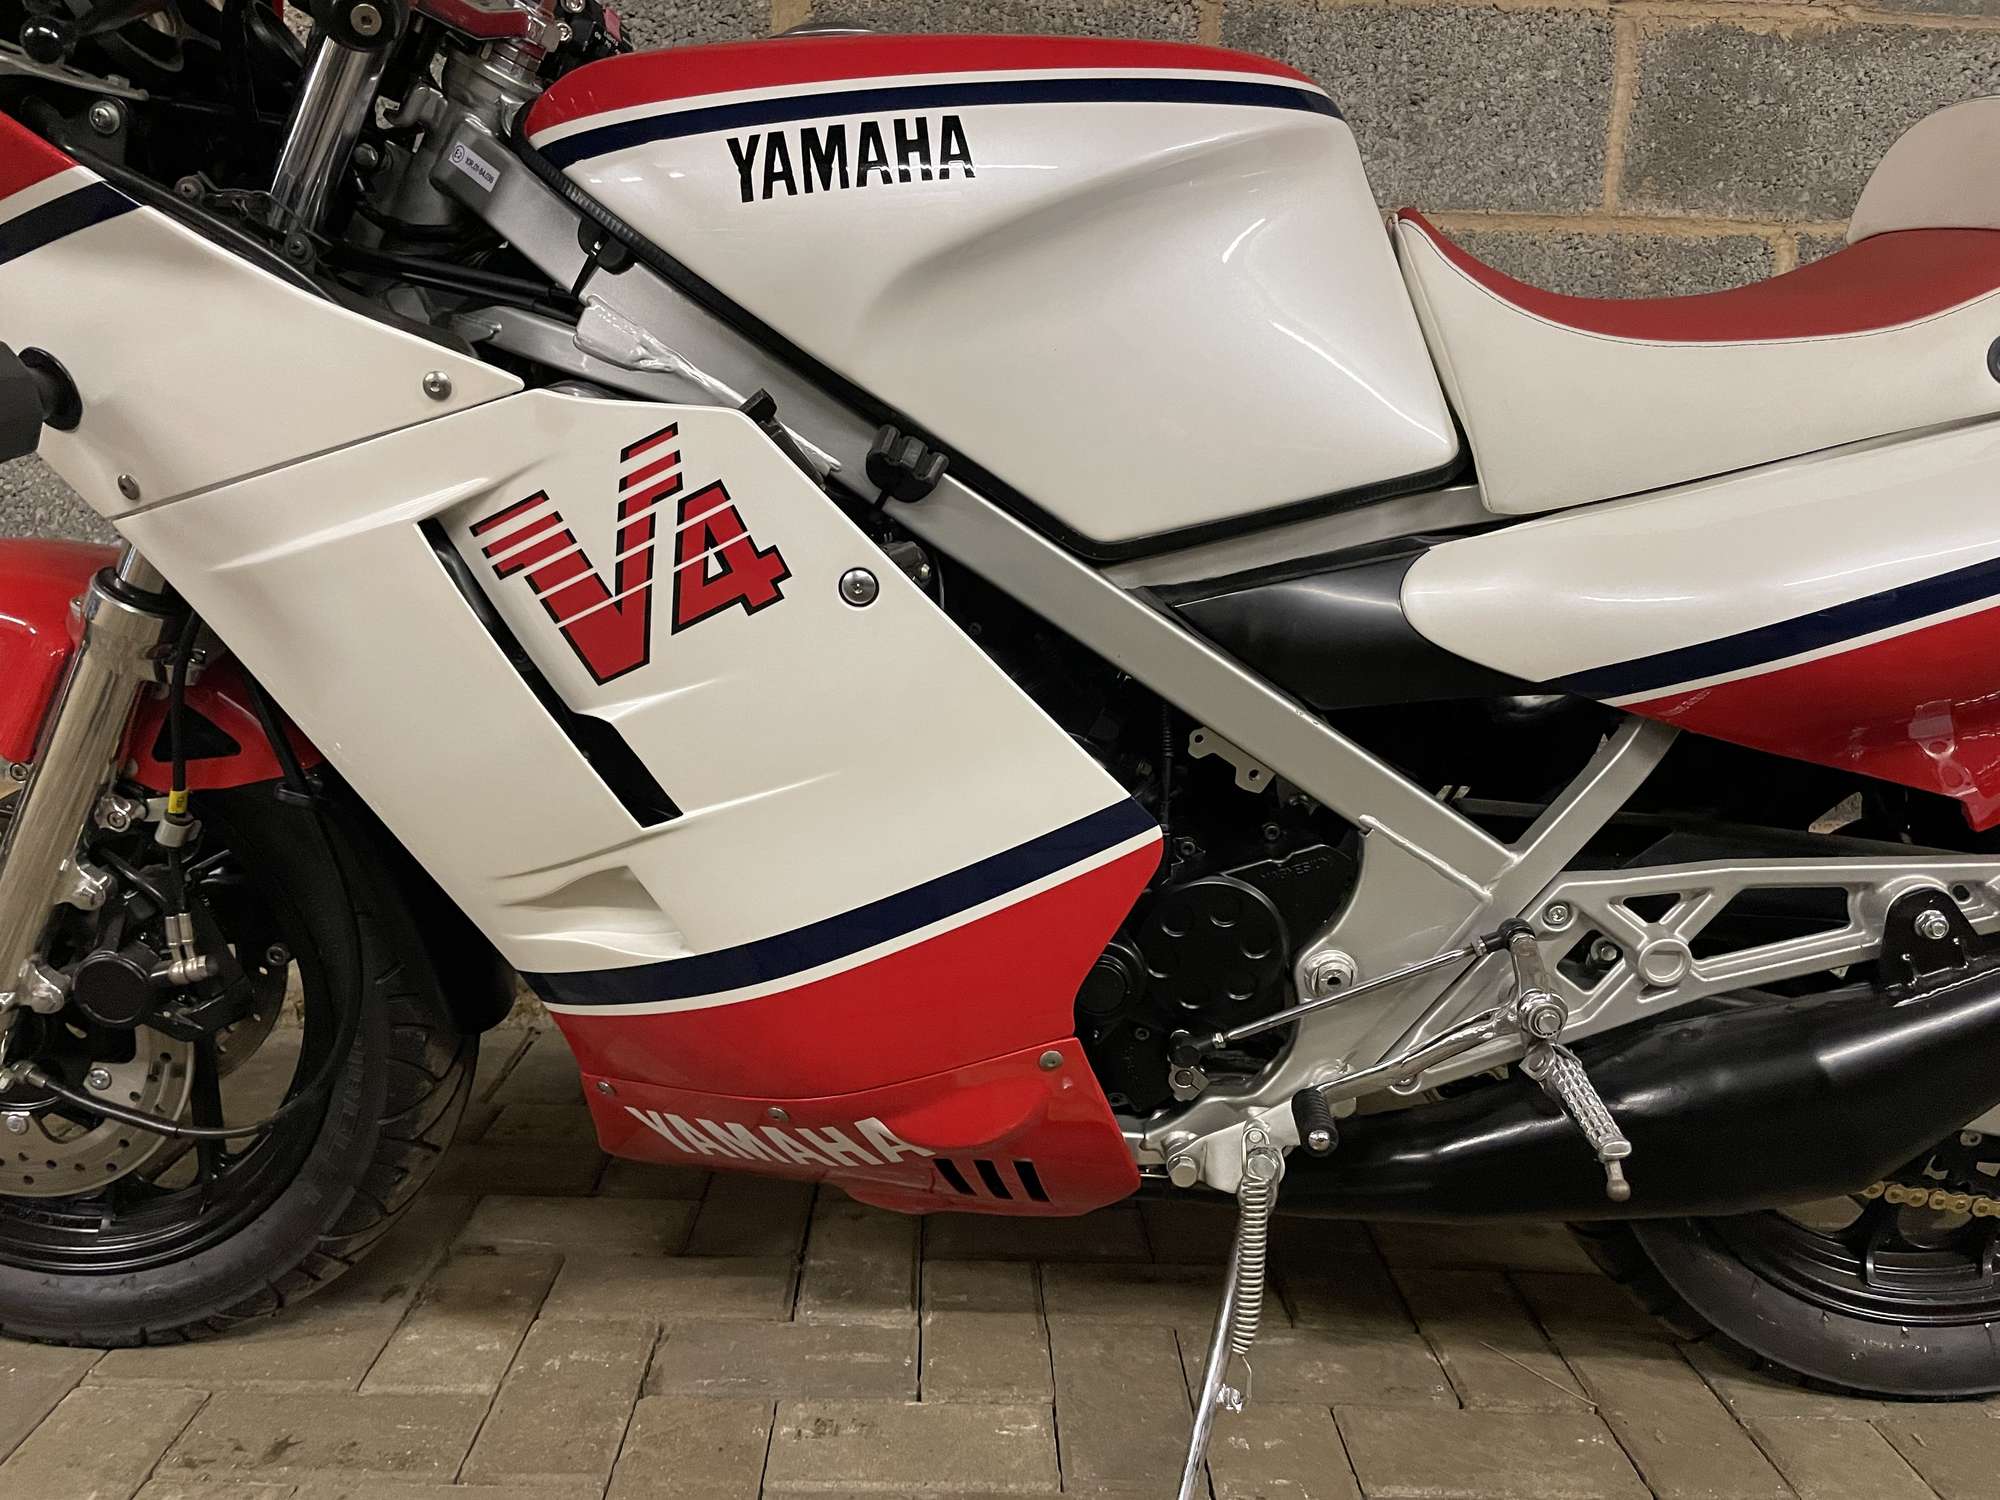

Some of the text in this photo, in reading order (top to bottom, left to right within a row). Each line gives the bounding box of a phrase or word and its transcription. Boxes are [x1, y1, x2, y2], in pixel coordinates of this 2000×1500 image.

[726, 115, 976, 203] YAMAHA
[468, 421, 793, 686] V4
[624, 1105, 936, 1167] YAMAHA
